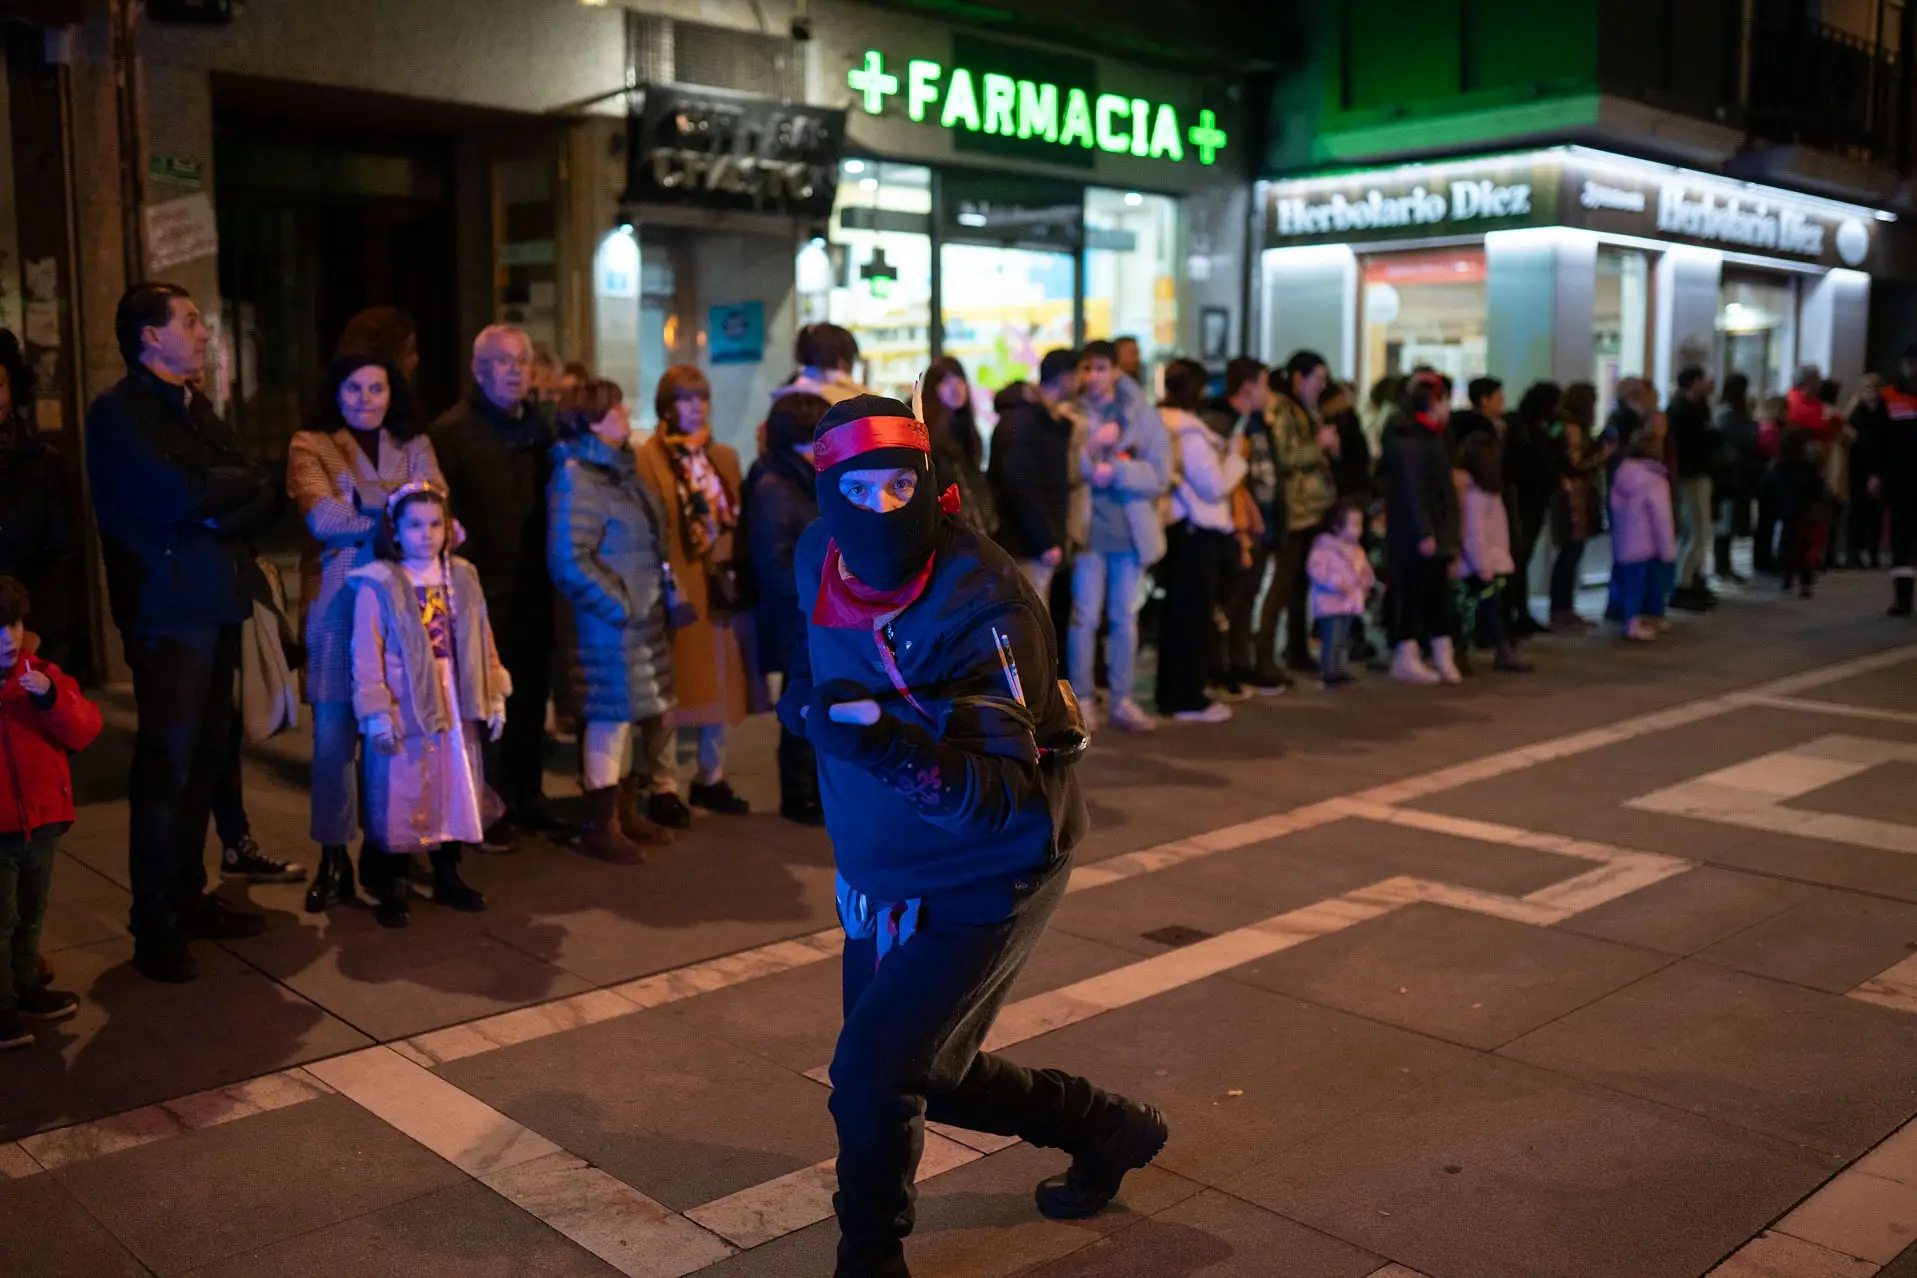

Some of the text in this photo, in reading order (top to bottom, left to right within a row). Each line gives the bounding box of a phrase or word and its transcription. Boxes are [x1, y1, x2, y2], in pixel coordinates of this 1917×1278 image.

[908, 59, 1184, 162] FARMACIA
[1276, 187, 1448, 236] Herbolario
[1450, 180, 1532, 221] Diez
